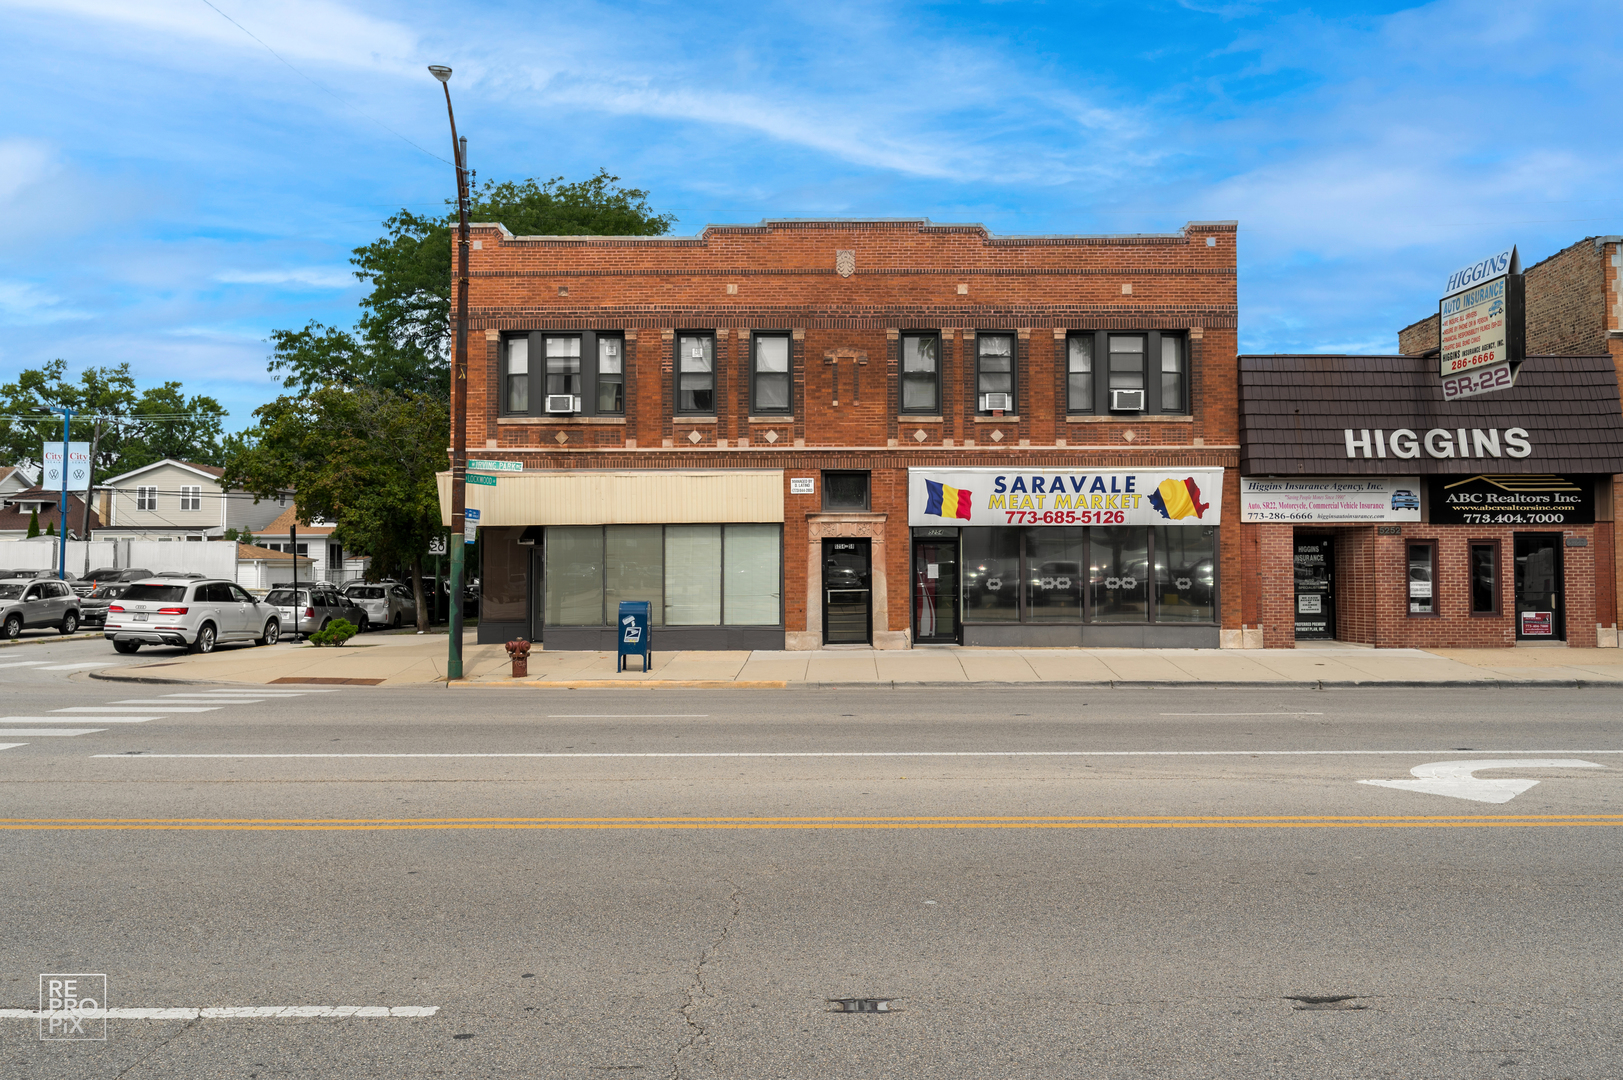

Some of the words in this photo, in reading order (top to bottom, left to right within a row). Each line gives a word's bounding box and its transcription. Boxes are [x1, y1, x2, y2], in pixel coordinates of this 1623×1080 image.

[1446, 252, 1508, 292] HIGGINS
[1443, 297, 1460, 315] AUTO
[1463, 281, 1504, 308] INSURANCE
[1443, 350, 1460, 362] HIGGINS
[1462, 346, 1480, 357] INSURANCE
[1452, 351, 1494, 370] 286-6666
[1444, 367, 1510, 397] SR-22
[1344, 427, 1532, 459] HIGGINS
[45, 452, 62, 461] City
[70, 452, 88, 461] City
[476, 461, 497, 469] IRVING
[499, 462, 515, 470] PARK
[468, 475, 492, 484] LOCKWOOD
[994, 476, 1136, 493] SARAVALE
[1248, 482, 1282, 491] Higgins
[1285, 482, 1330, 490] Insurance
[1330, 482, 1363, 491] Agency,
[1367, 482, 1383, 490] Inc.
[988, 494, 1046, 509] MEAT
[1054, 494, 1142, 509] MARKET
[1446, 493, 1482, 503] ABC
[1486, 493, 1550, 503] Realtors
[1554, 493, 1581, 503] Inc.
[1248, 502, 1261, 510] Auto,
[1263, 502, 1277, 510] SR22,
[1279, 502, 1308, 511] Motorcycle,
[1309, 502, 1339, 510] Commercial
[1340, 502, 1358, 510] Vehicle
[1360, 502, 1384, 510] Insurance
[1005, 511, 1125, 524] 773-685-5126
[1463, 514, 1564, 523] 773.404.7000
[1380, 527, 1400, 535] 5252
[430, 543, 444, 551] 20
